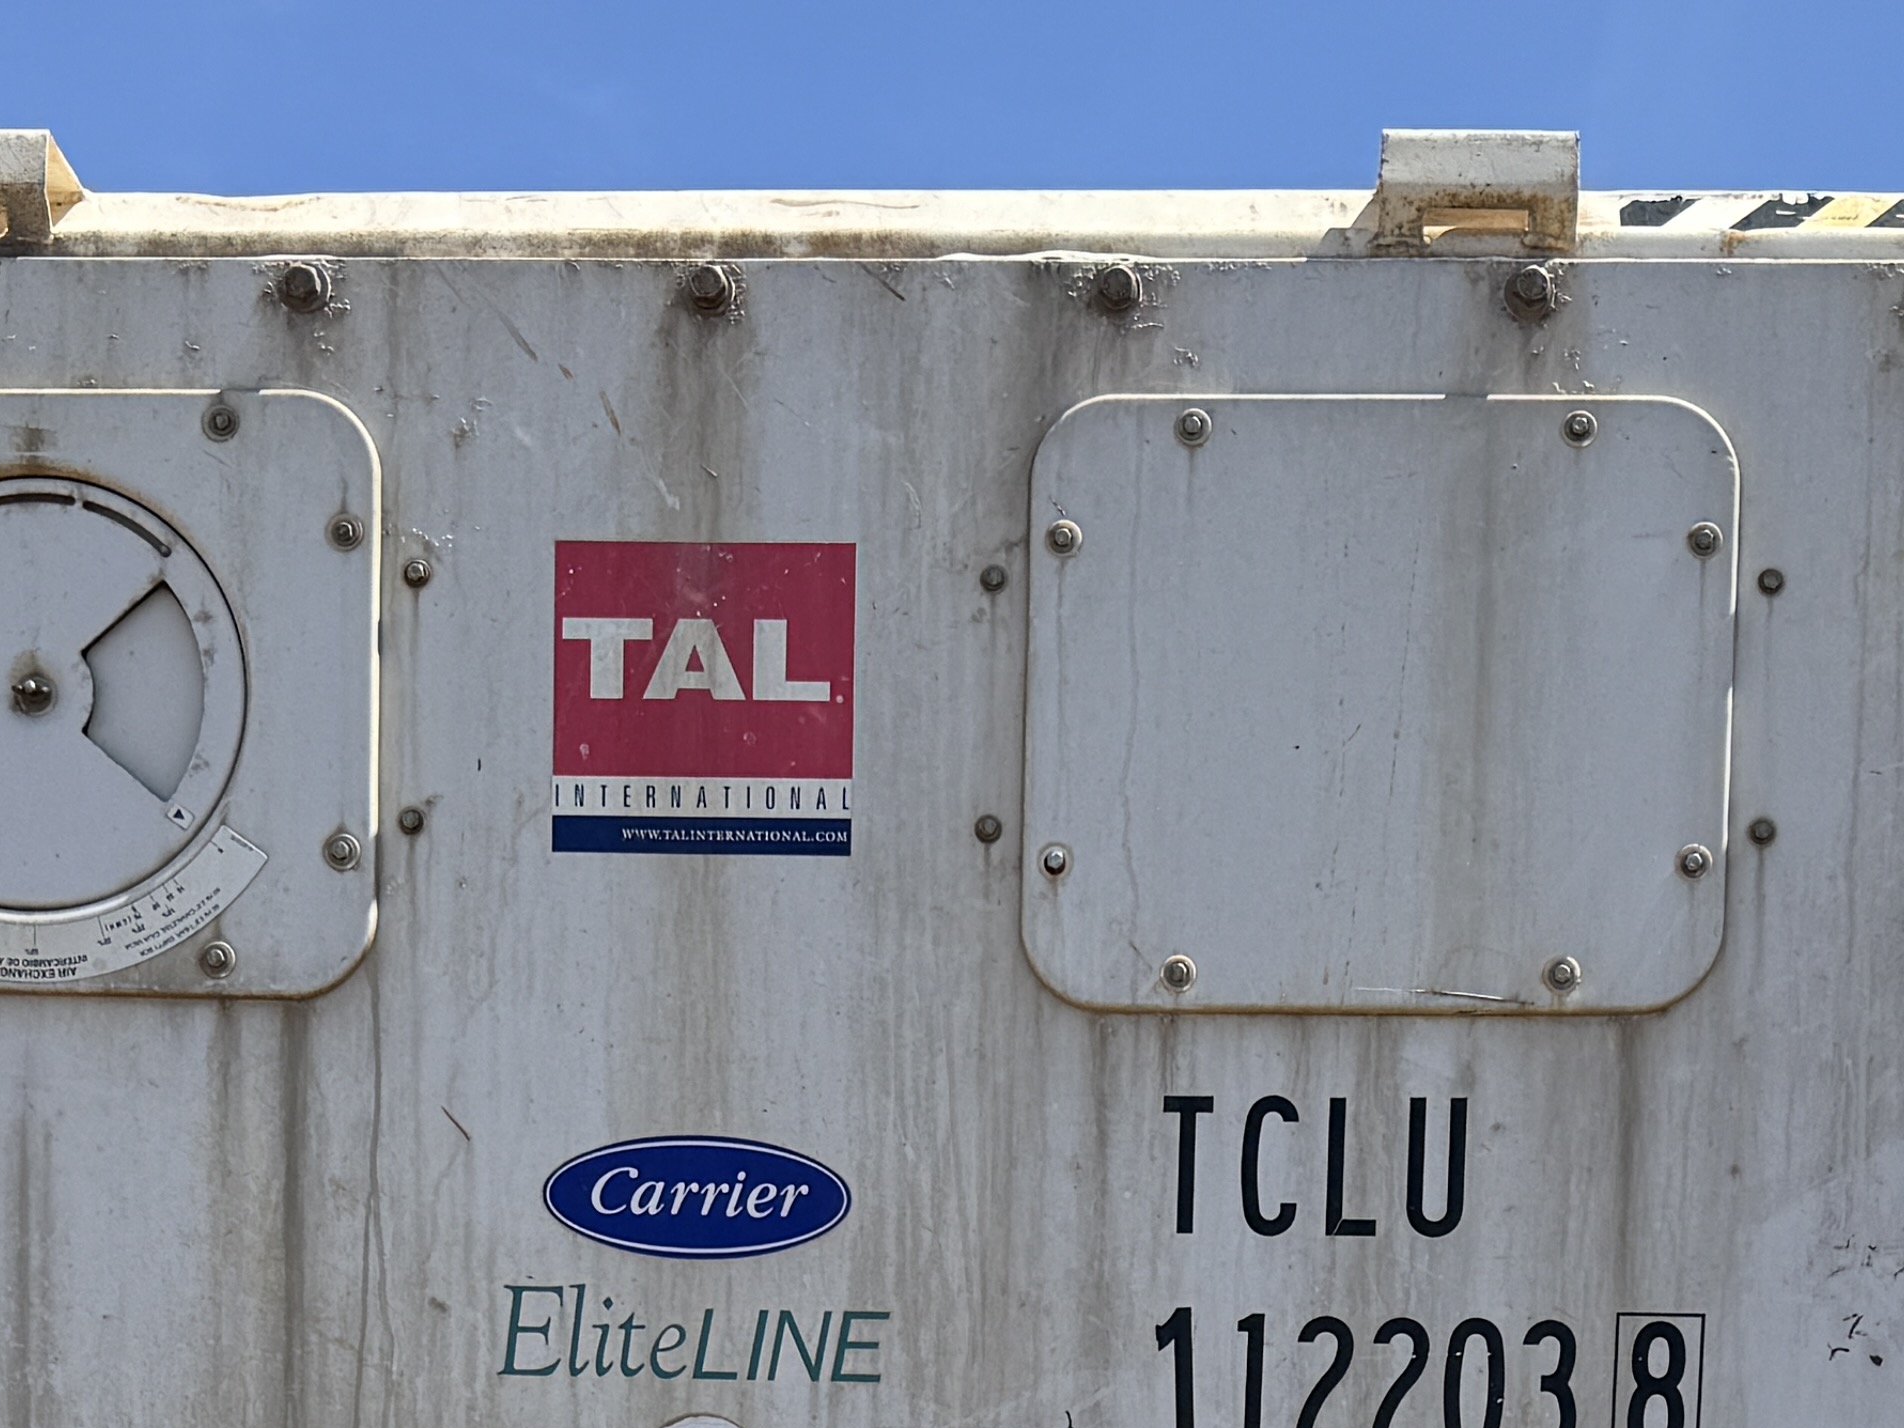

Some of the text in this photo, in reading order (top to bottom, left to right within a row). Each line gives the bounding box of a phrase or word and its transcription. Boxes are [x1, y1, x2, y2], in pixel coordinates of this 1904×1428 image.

[562, 617, 831, 701] TAL
[555, 784, 849, 811] INTERNATIONAL
[622, 827, 848, 843] WWW.TALINTERNATIONAL.COM
[590, 1166, 809, 1219] Carrier
[1163, 1094, 1468, 1238] TCLU
[497, 1283, 891, 1383] EliteLINE
